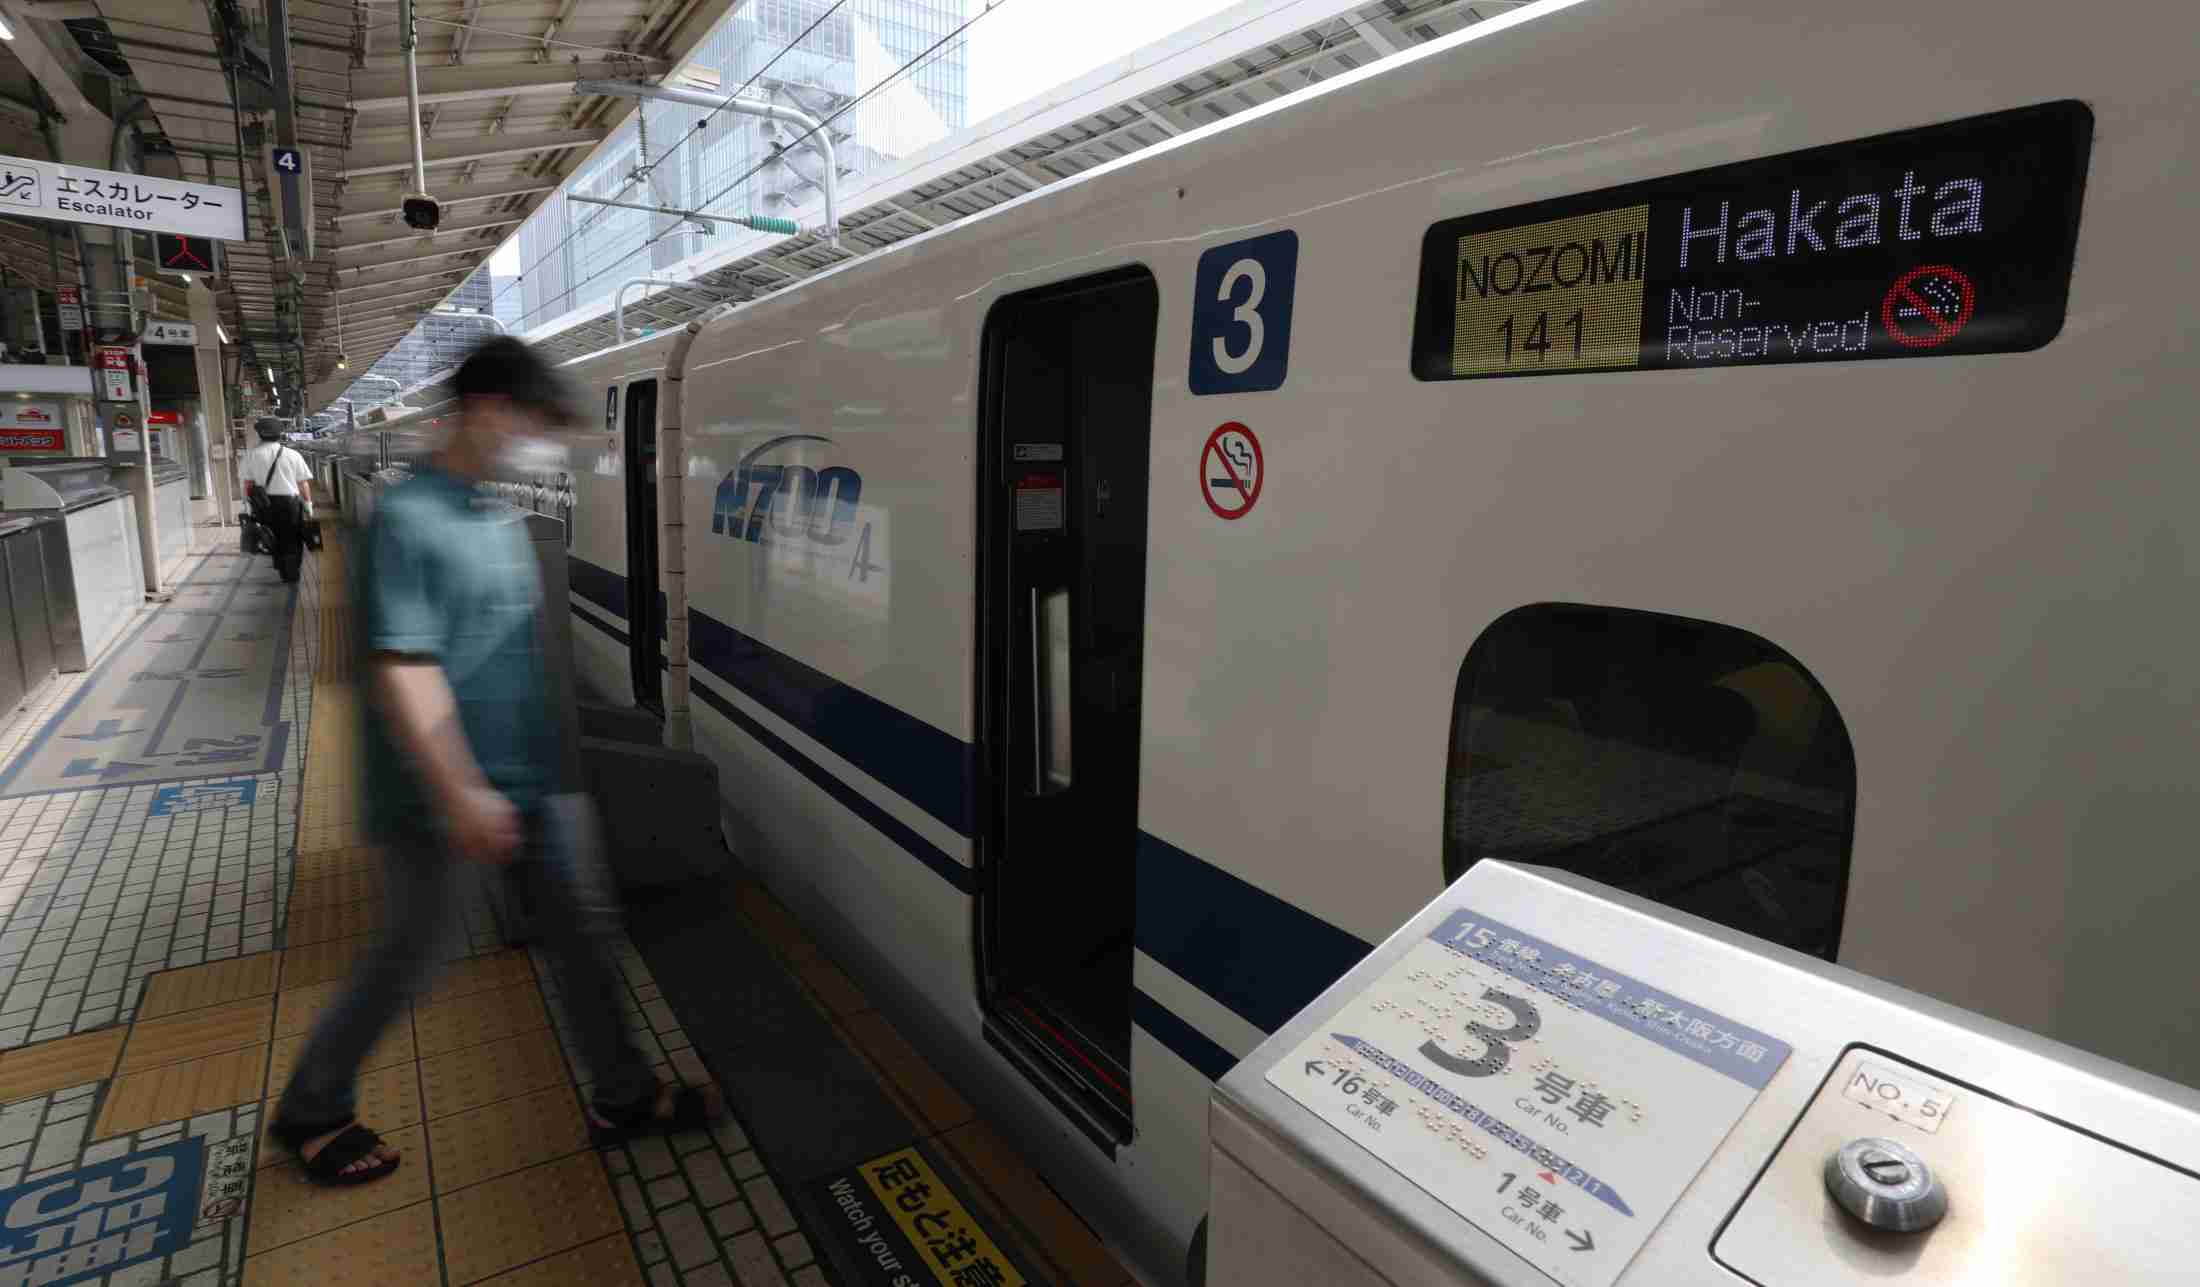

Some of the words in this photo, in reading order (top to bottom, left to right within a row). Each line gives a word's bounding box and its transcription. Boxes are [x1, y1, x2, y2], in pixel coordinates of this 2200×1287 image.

[278, 153, 296, 171] 4
[57, 176, 222, 210] エスカレーター
[57, 197, 153, 221] Escalator
[1680, 170, 1984, 268] Hakata
[1459, 231, 1646, 300] NOZOMI
[1213, 258, 1266, 374] 3
[1668, 285, 1761, 325] Non-
[1499, 308, 1584, 363] 141
[1665, 310, 1871, 361] Reserved
[1418, 987, 1541, 1078] 3
[1346, 1103, 1364, 1119] Car
[1515, 1097, 1541, 1117] Car
[1543, 1112, 1569, 1137] No.
[1533, 1071, 1617, 1128] 号車
[828, 1177, 873, 1232] Watch
[856, 1226, 903, 1273] your
[871, 1157, 1007, 1287] 足もと注意
[1501, 1206, 1524, 1225] Car
